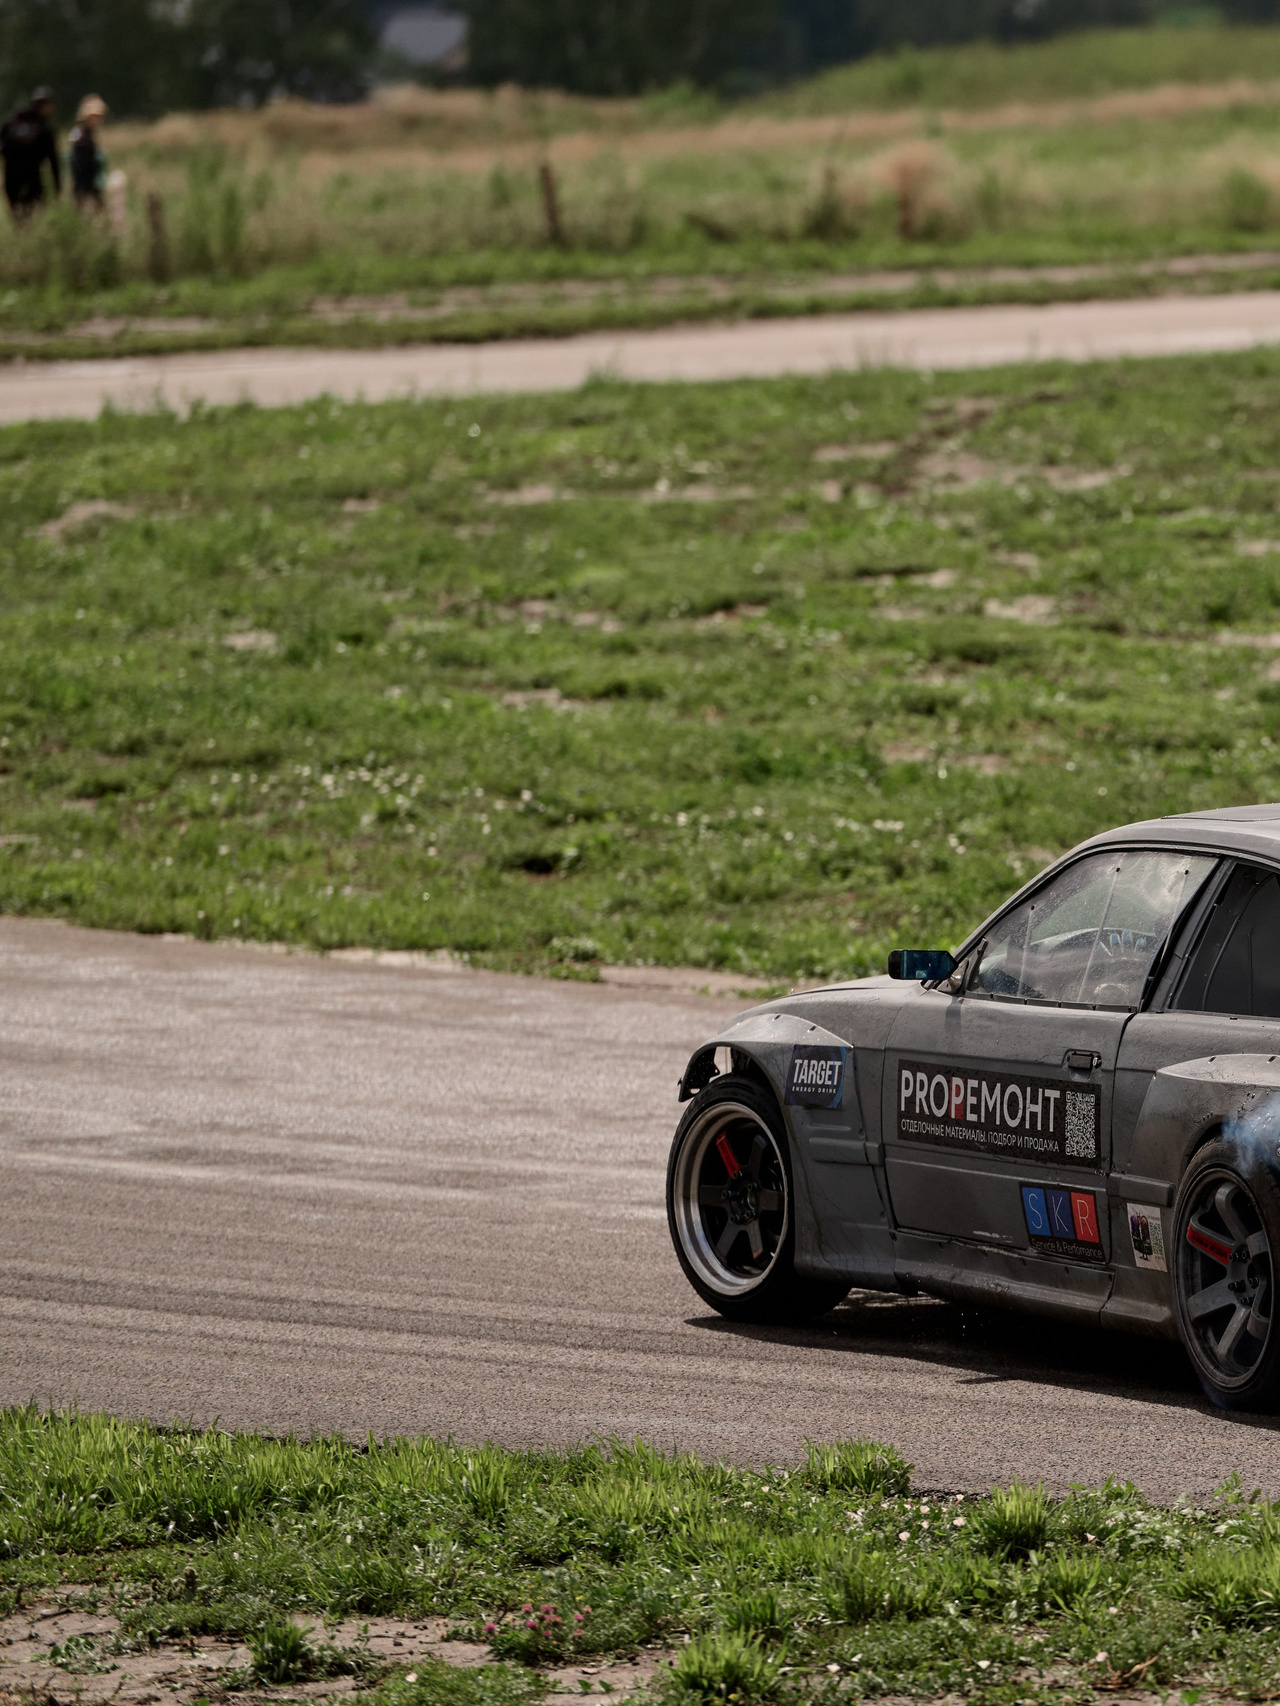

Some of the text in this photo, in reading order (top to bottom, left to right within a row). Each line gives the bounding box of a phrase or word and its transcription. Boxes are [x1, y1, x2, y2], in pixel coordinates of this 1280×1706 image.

[793, 1059, 843, 1086] TARGET
[901, 1119, 944, 1137] ОТДЕЛОЧНЫЕ
[988, 1131, 1016, 1147] ПОДБОР
[1017, 1136, 1023, 1148] И
[1024, 1136, 1060, 1153] ПРОДАЖА
[1031, 1238, 1055, 1252] Service
[1056, 1241, 1062, 1253] &
